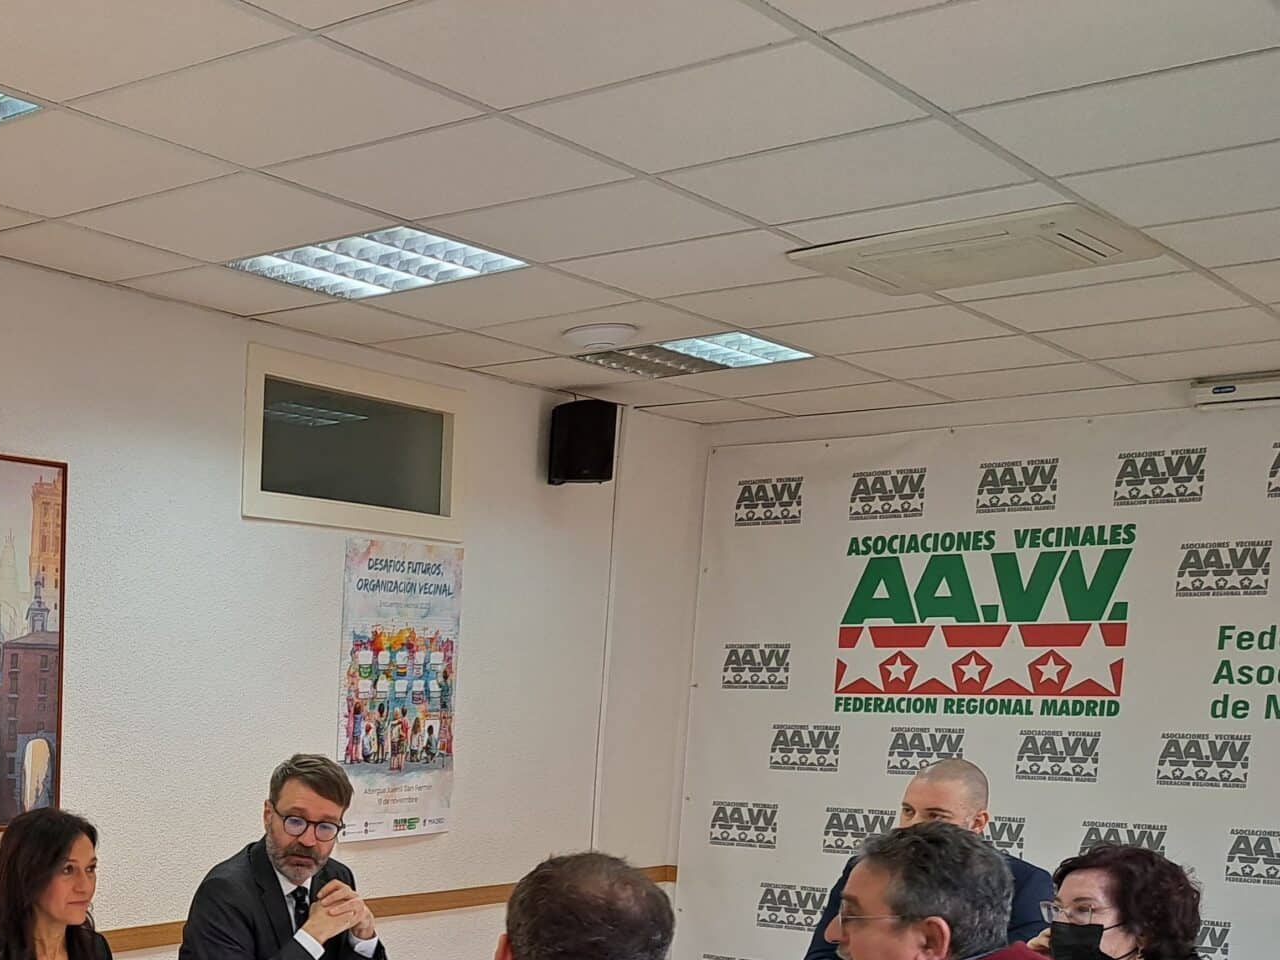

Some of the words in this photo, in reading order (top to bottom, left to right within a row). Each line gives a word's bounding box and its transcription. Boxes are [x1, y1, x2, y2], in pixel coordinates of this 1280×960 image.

[978, 464, 1058, 488] AA.VV.
[1116, 454, 1206, 479] AA.VV.
[736, 482, 802, 504] AA.VV.
[851, 473, 926, 497] AA.VV.
[847, 530, 996, 557] ASOCIACIONES
[1014, 524, 1136, 549] VECINALES
[1178, 547, 1272, 570] AA.VV.
[840, 548, 1134, 625] AA.VV.
[1217, 624, 1280, 650] Fed
[723, 649, 790, 667] AA.VV.
[1212, 659, 1280, 685] Aso
[834, 696, 938, 714] FEDERACION
[943, 697, 1034, 716] REGIONAL
[1039, 699, 1121, 717] MADRID
[1210, 693, 1250, 719] de
[771, 729, 840, 749] AA.VV.
[889, 732, 965, 753] AA.VV.
[1018, 735, 1100, 757] AA.VV.
[1159, 739, 1250, 762] AA.VV.
[711, 806, 778, 827] AA.VV.
